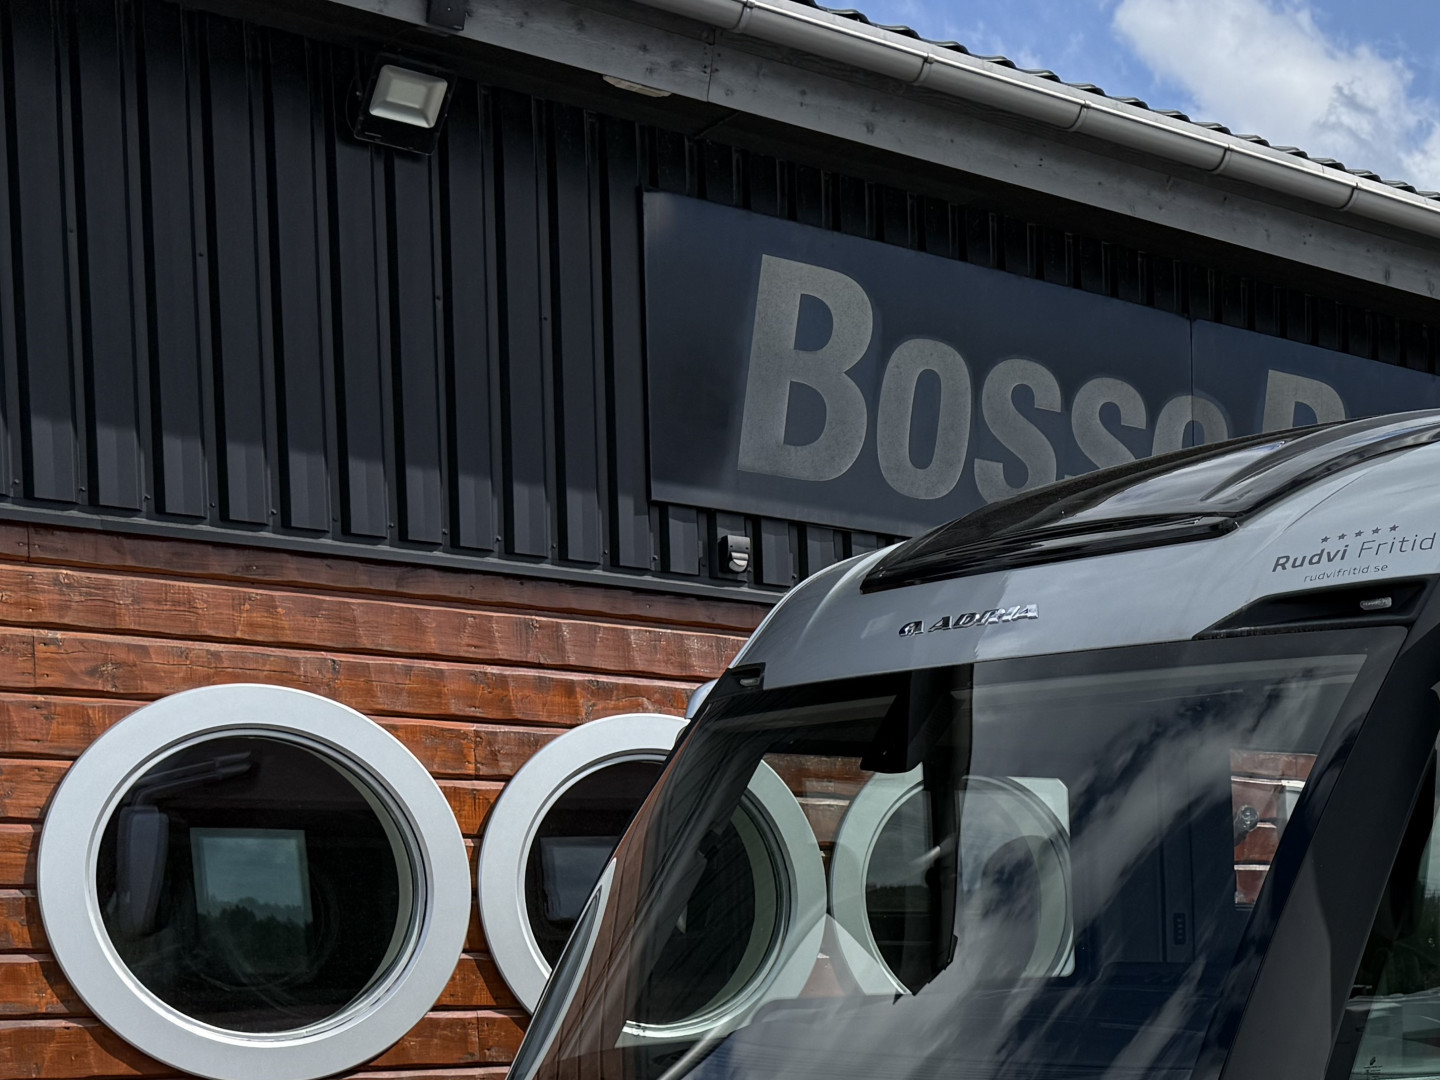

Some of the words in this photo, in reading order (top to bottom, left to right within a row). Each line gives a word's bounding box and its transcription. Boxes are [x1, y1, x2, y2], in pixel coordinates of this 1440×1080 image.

[1271, 544, 1349, 573] Rudvi
[1357, 532, 1437, 559] Fritid
[928, 604, 1039, 633] ADRIA
